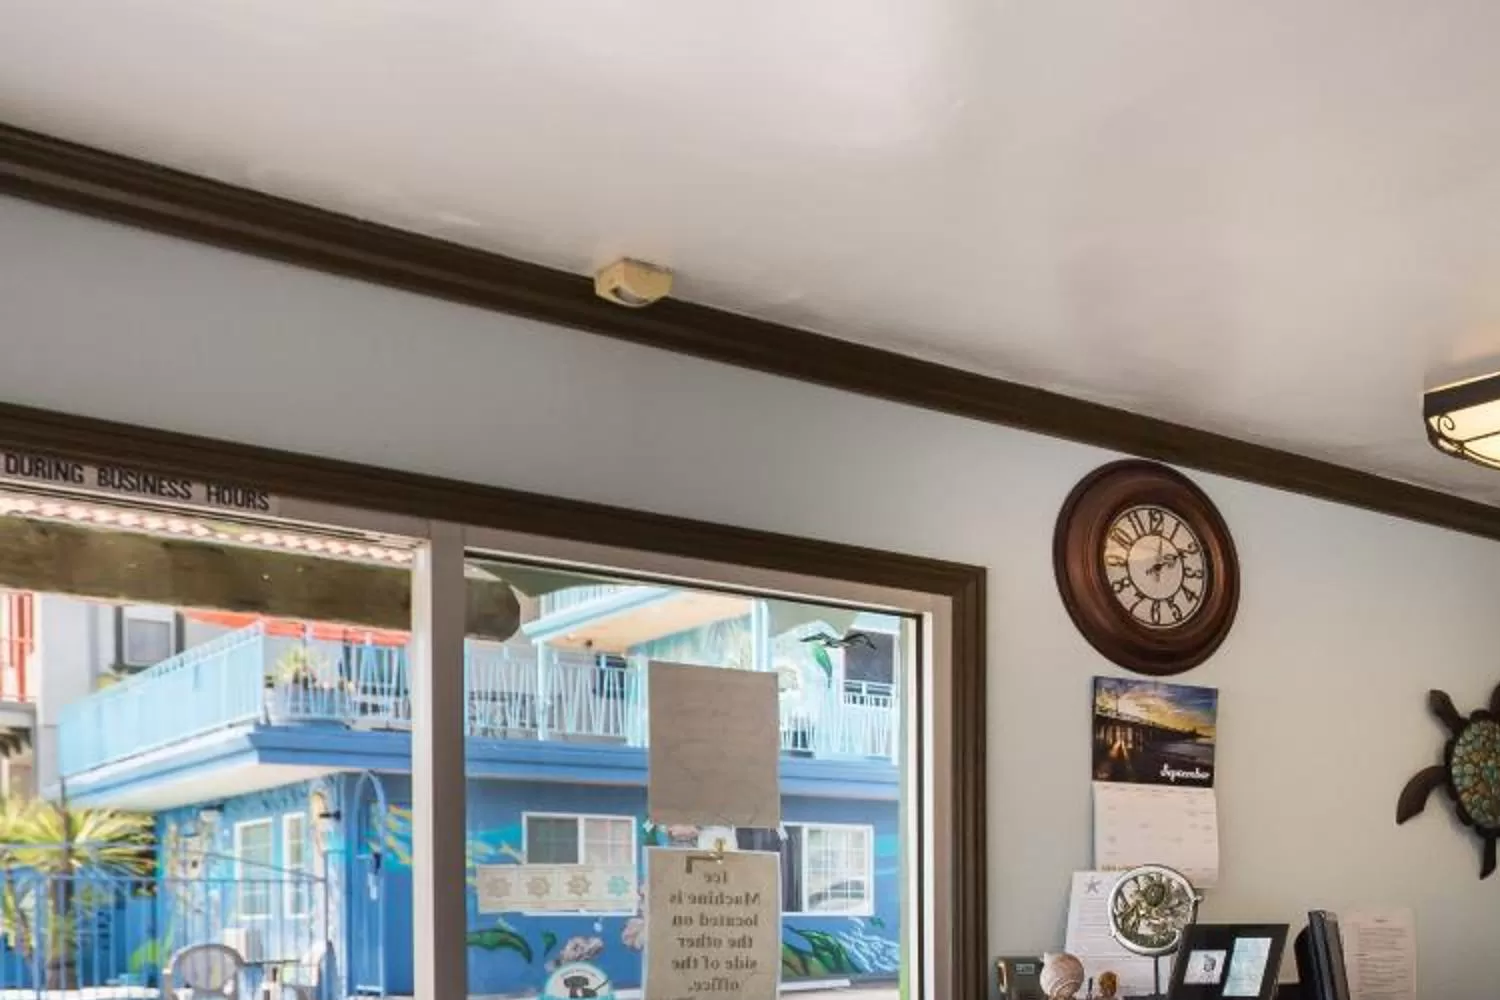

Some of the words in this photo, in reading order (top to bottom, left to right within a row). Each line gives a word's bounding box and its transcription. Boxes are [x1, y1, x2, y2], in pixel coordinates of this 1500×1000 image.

[5, 453, 84, 484] DURING
[97, 466, 192, 499] BUSINESS
[206, 480, 269, 511] HOURS
